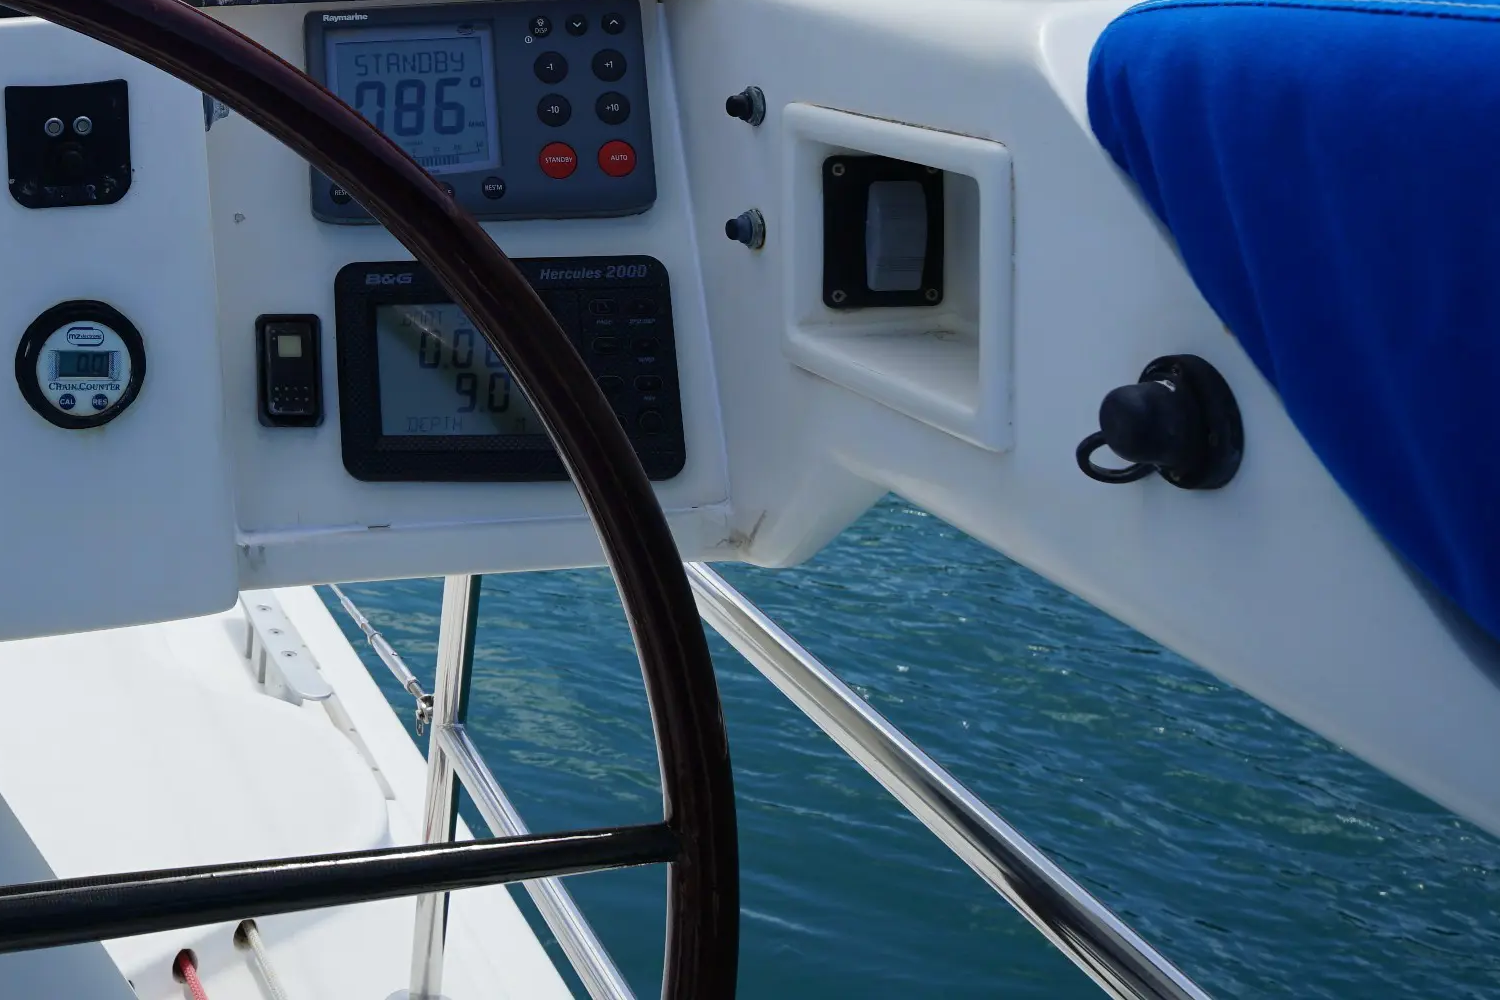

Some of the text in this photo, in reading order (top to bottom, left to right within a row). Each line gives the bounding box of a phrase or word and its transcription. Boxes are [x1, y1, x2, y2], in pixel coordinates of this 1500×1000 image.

[322, 13, 369, 24] Raymarine
[534, 26, 548, 34] DISP
[354, 51, 465, 77] STANDBY
[545, 63, 554, 71] -1
[604, 60, 614, 69] +1
[546, 104, 561, 114] -10
[605, 102, 620, 113] +10
[544, 156, 573, 165] STANDBY
[610, 153, 629, 162] AUTO
[540, 264, 649, 281] Hercules 2000
[365, 272, 414, 286] B&G
[49, 382, 121, 391] CHAIN COUNTER
[60, 398, 76, 406] CAL
[92, 398, 108, 406] RES
[407, 415, 463, 434] DEPTH
